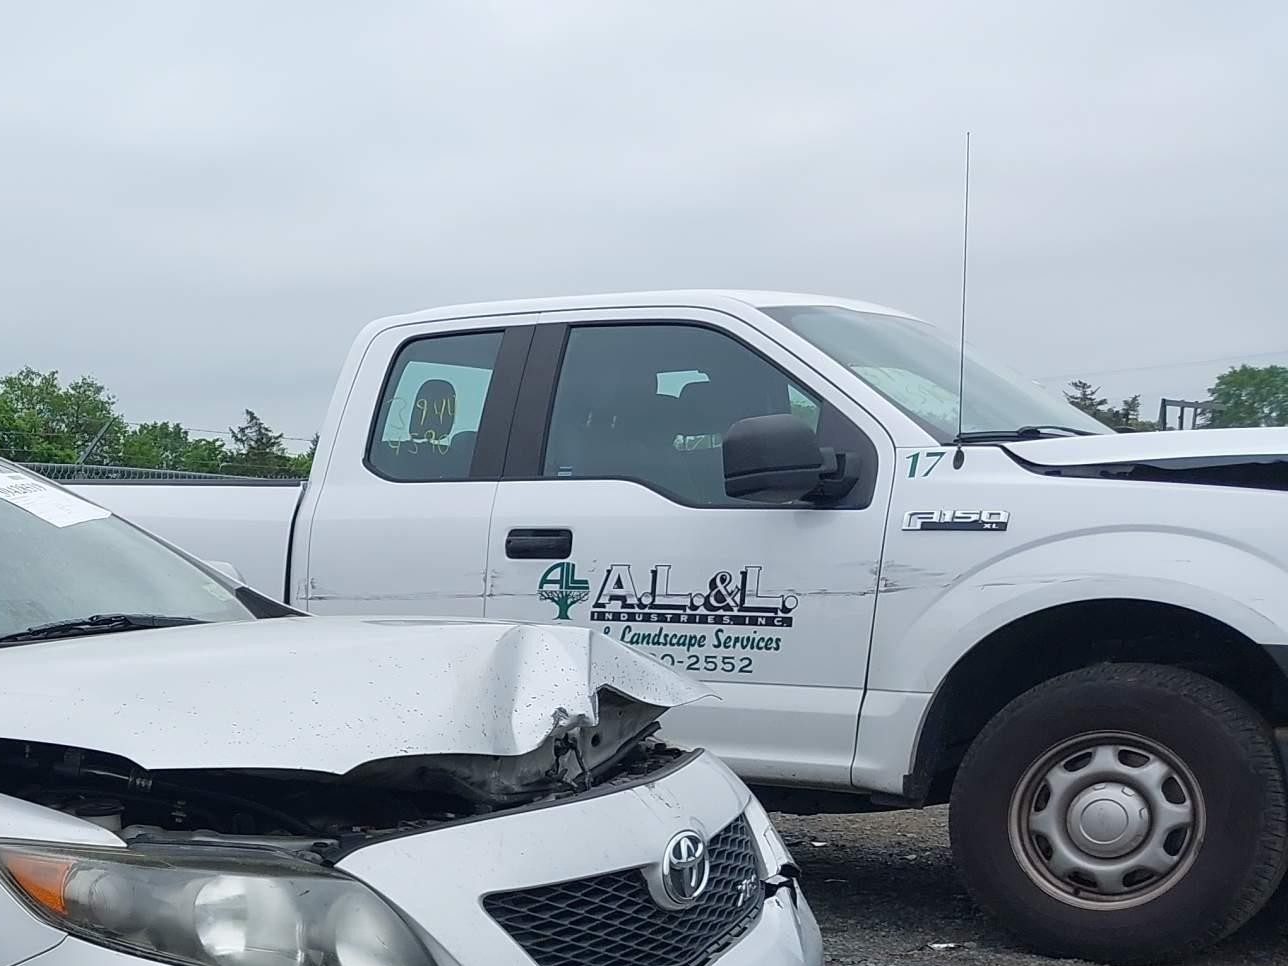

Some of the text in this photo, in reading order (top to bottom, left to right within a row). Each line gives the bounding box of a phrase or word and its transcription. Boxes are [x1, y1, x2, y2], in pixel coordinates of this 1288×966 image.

[906, 452, 947, 478] 17
[745, 616, 787, 627] INC.
[620, 625, 782, 652] Landscape Services
